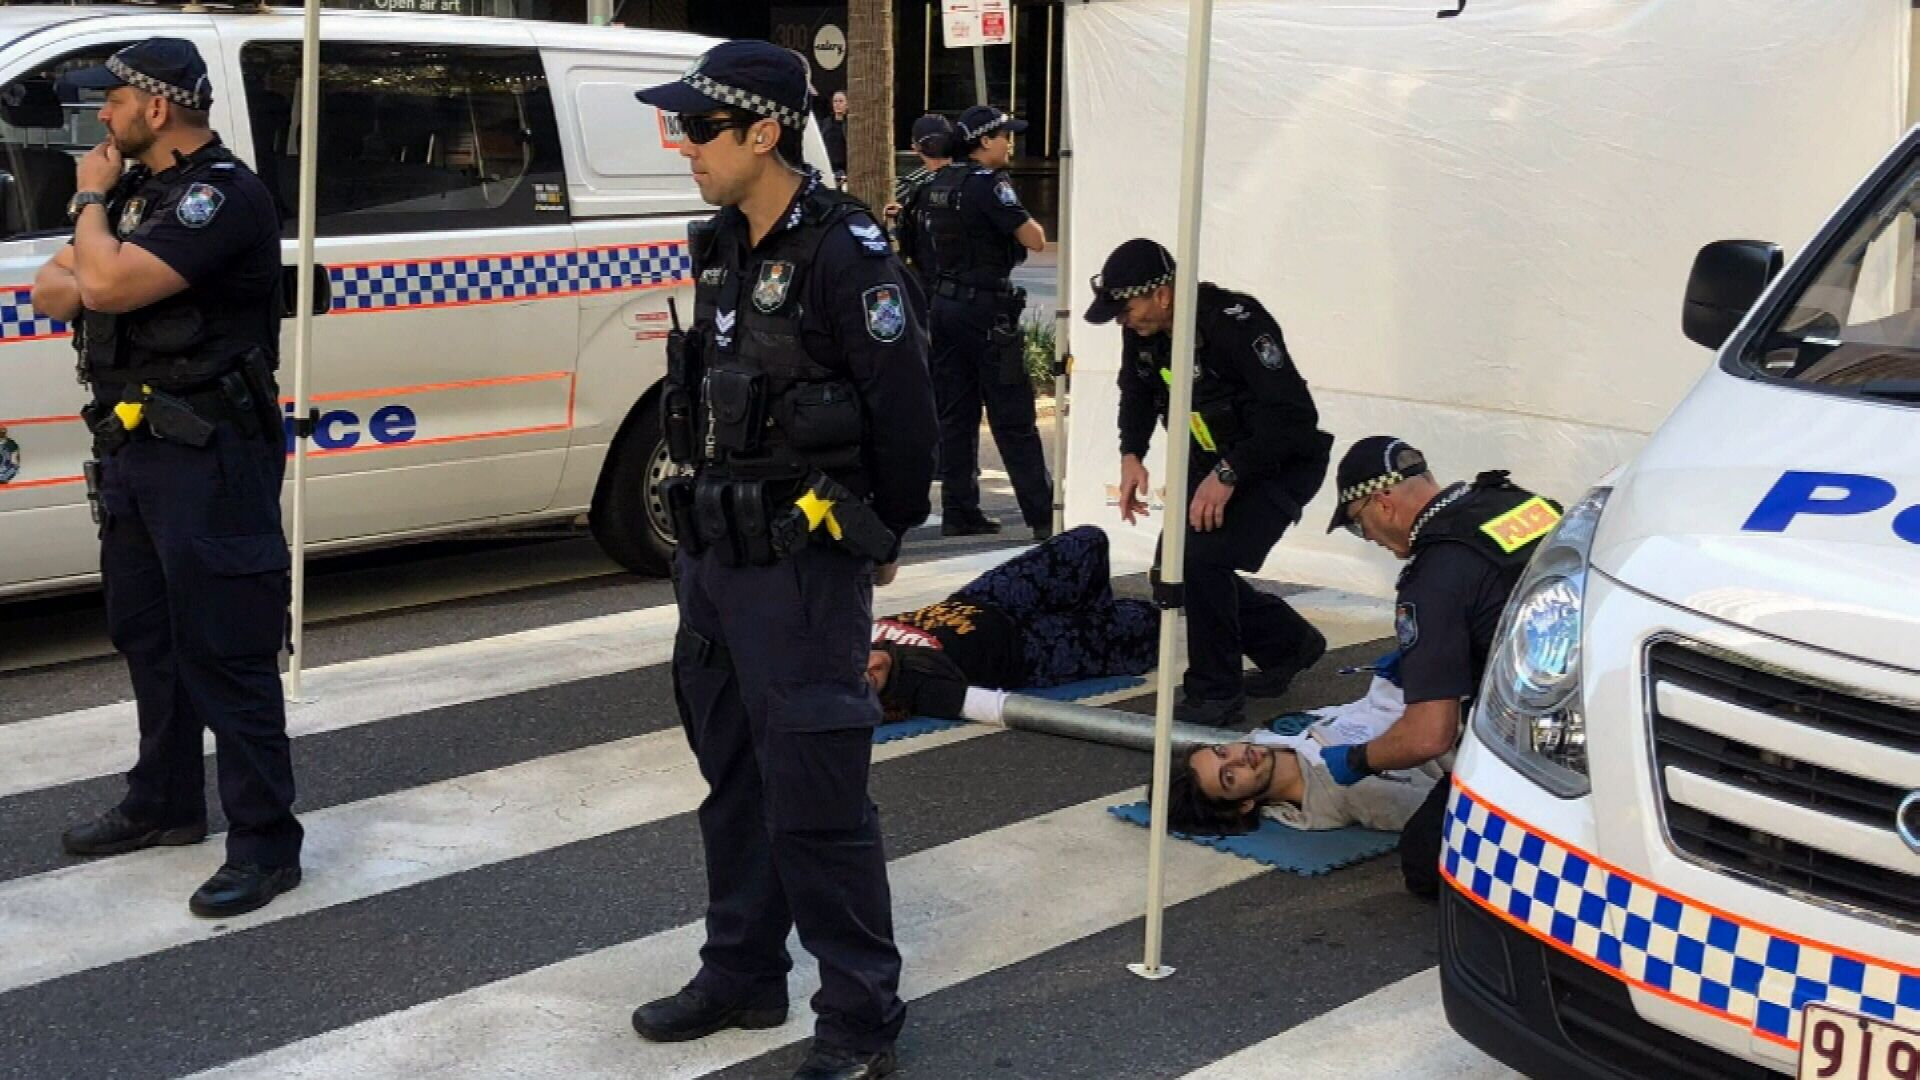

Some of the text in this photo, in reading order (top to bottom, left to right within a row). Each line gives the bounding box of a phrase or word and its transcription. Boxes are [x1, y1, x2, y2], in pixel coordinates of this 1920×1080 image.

[374, 0, 462, 13] Open air art
